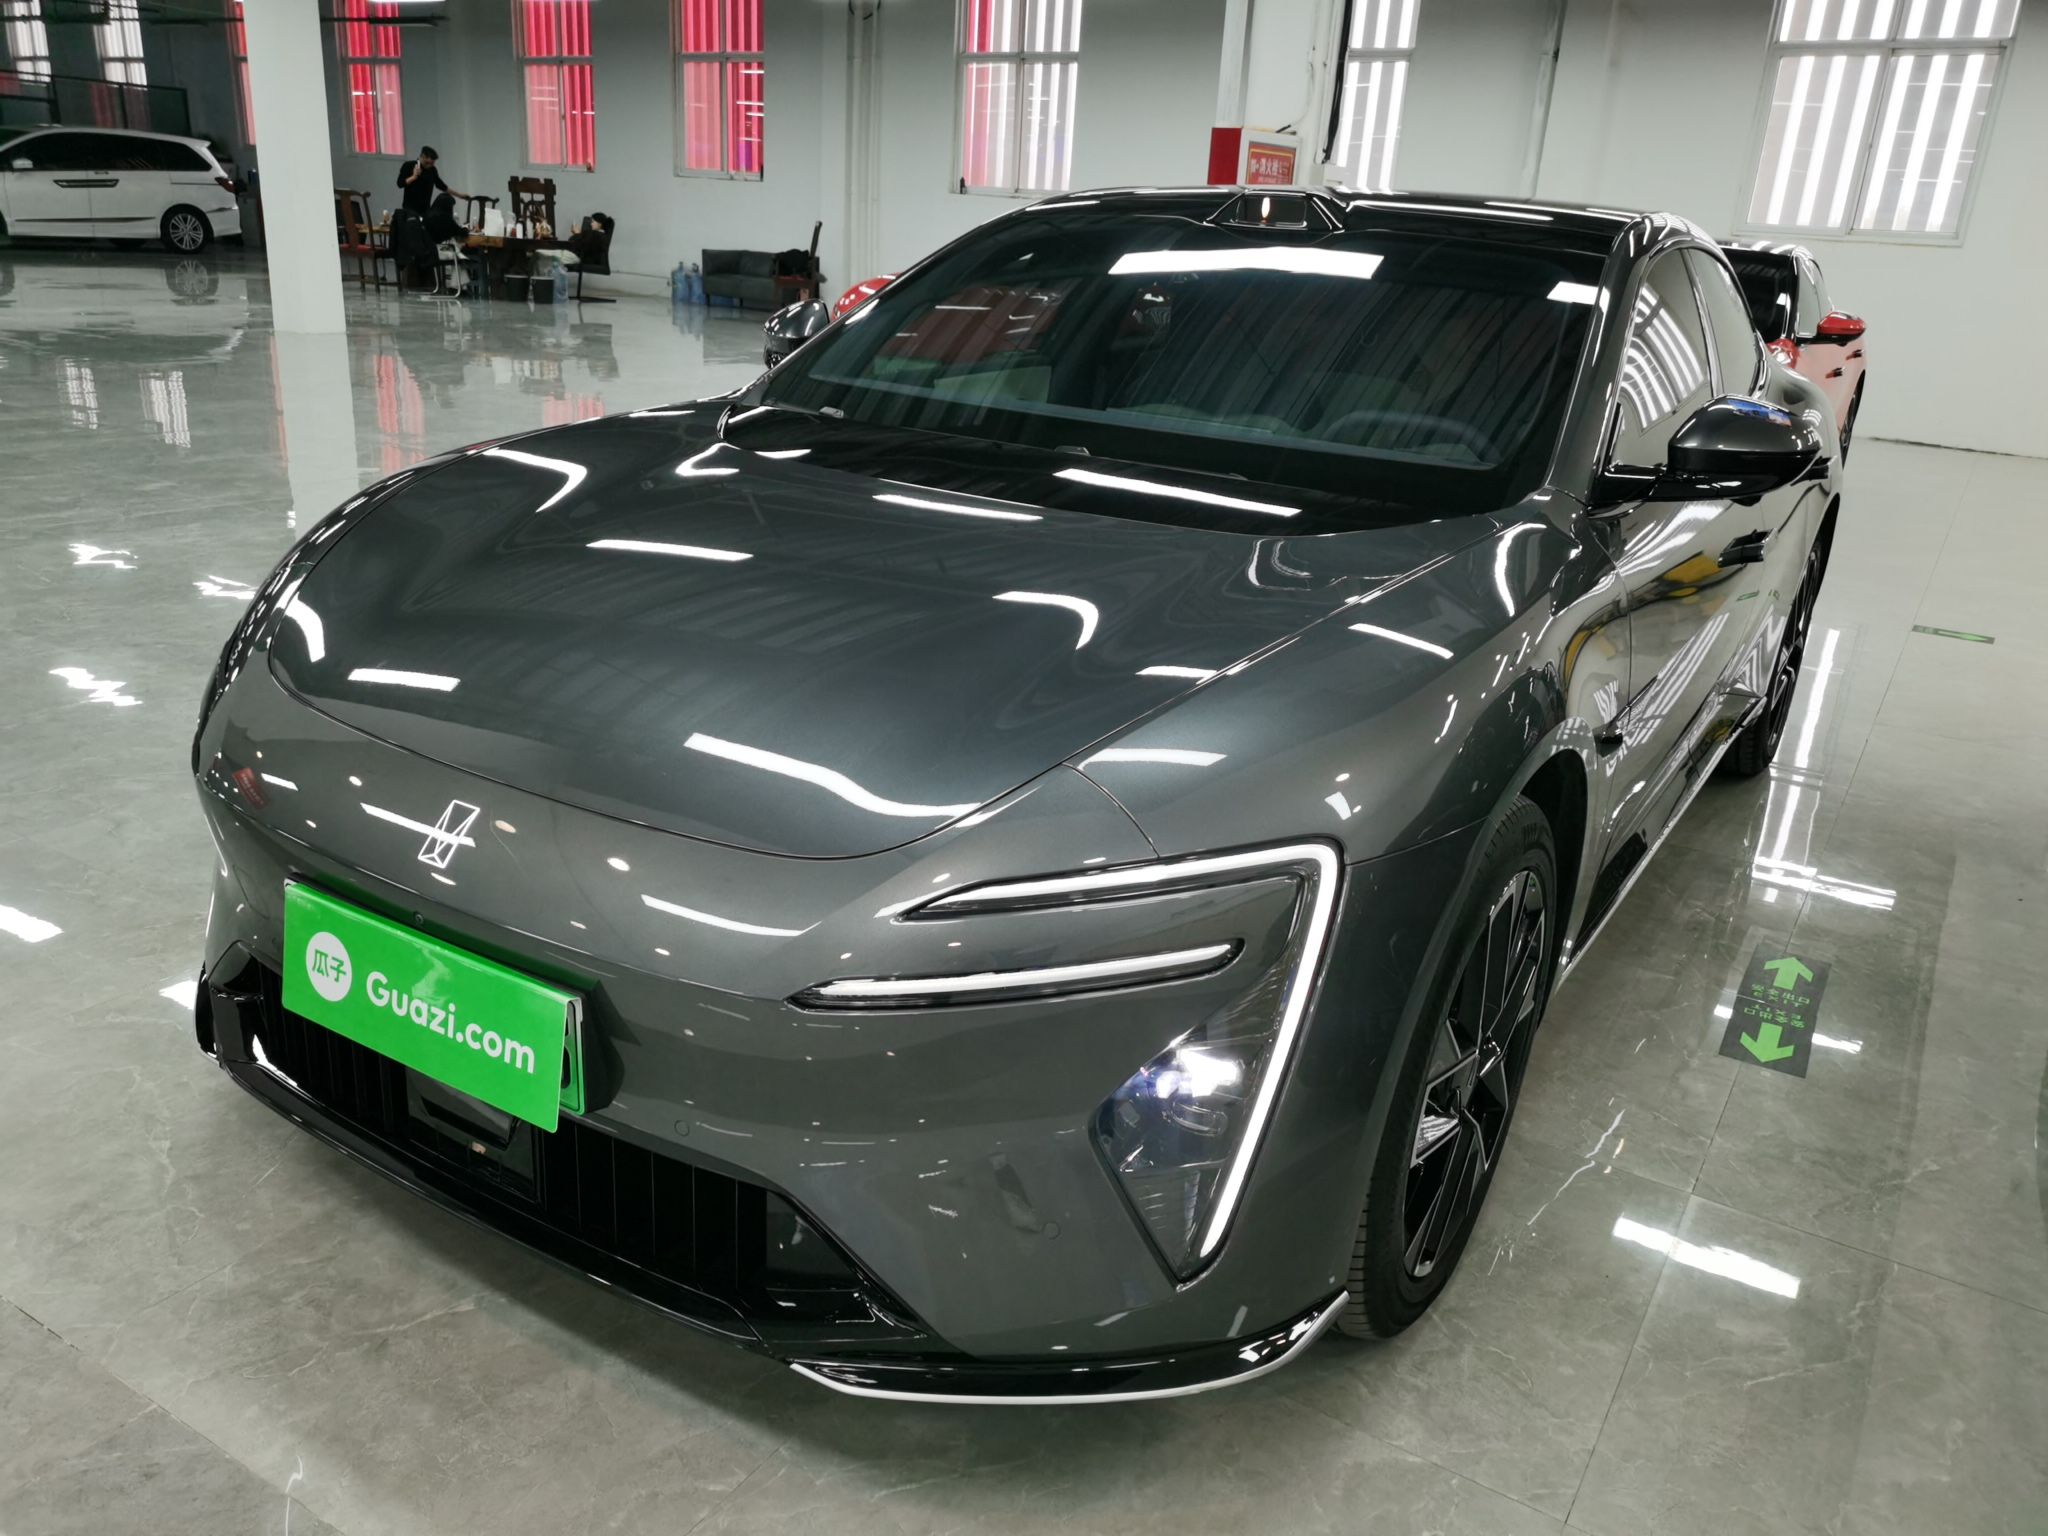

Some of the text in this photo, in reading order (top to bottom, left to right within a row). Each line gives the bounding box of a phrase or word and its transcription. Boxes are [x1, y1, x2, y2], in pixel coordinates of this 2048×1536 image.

[311, 948, 347, 982] 瓜子
[1752, 984, 1810, 1004] 安全出口
[366, 970, 535, 1074] Guazi.com
[1744, 1007, 1805, 1028] 安全出口
